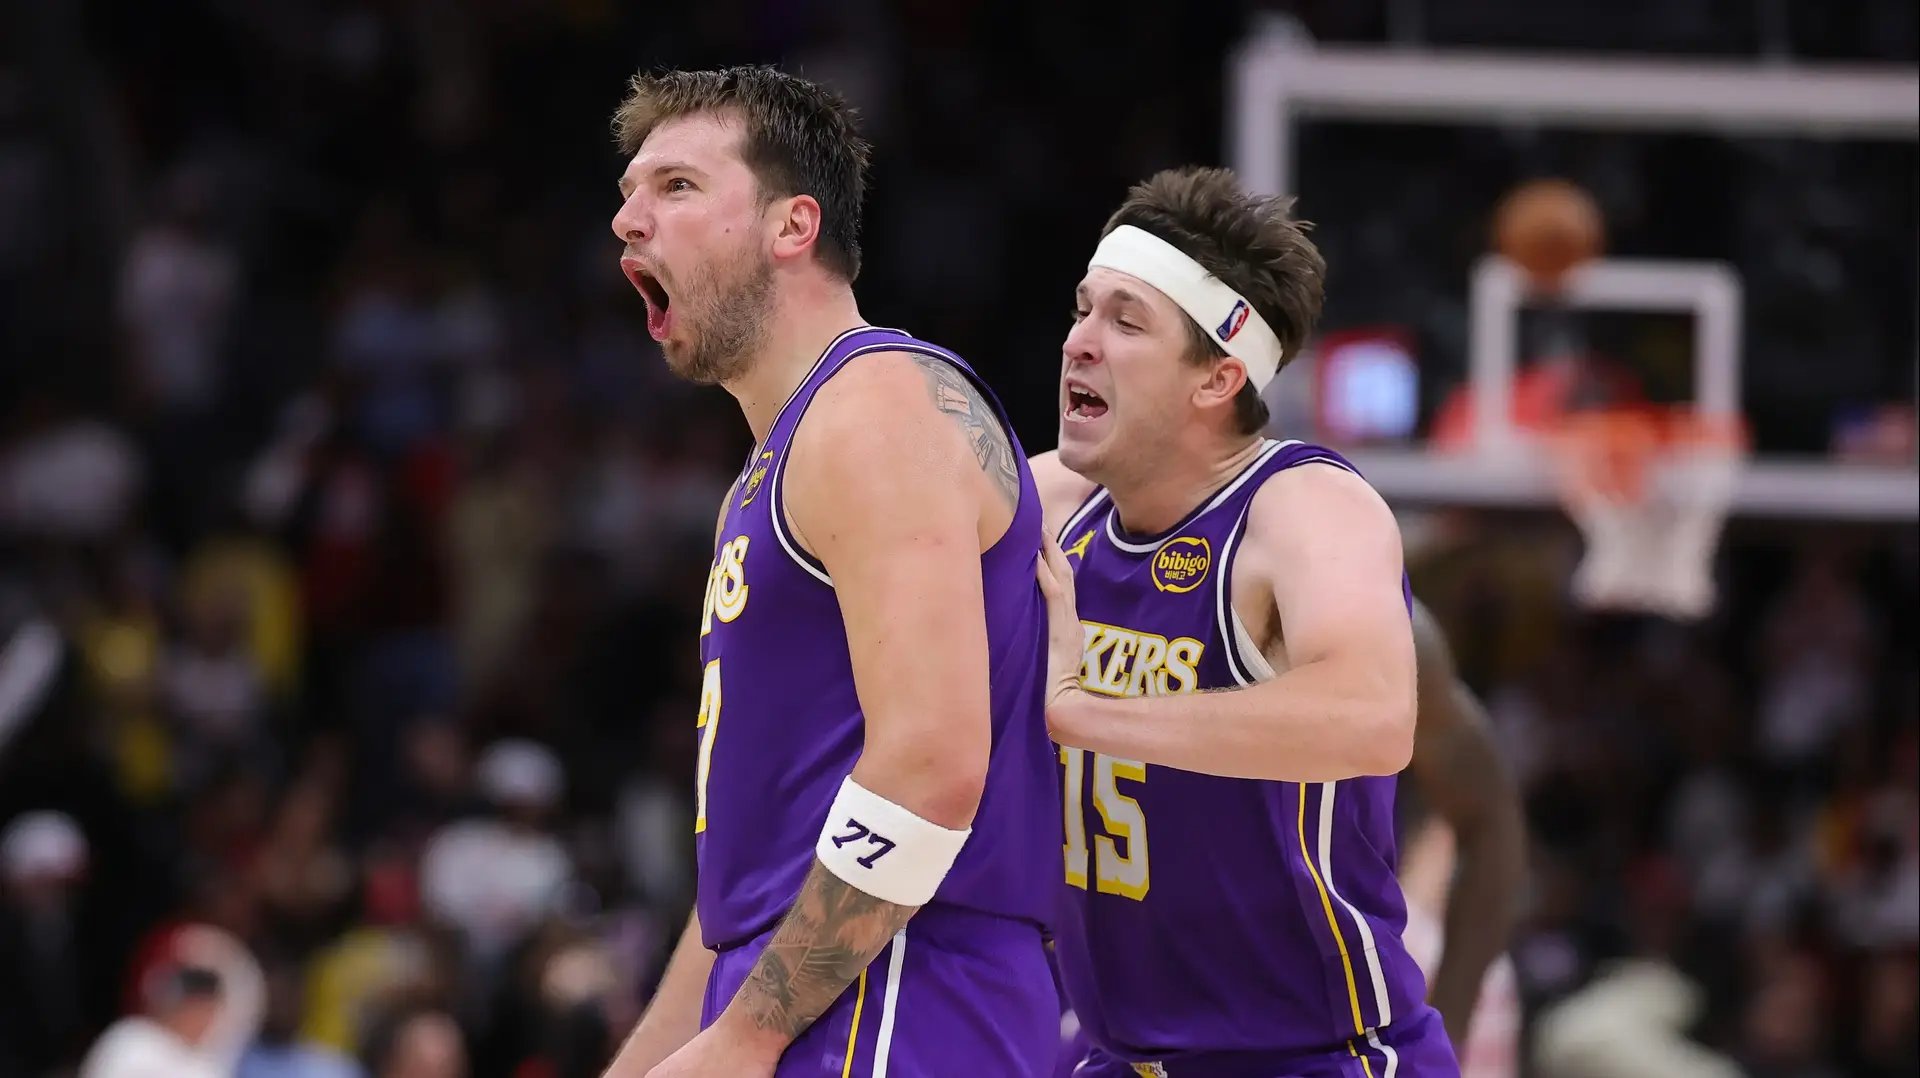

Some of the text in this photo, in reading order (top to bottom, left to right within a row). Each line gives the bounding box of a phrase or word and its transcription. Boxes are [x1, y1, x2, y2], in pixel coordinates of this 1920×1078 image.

[1158, 551, 1207, 577] bibigo
[1164, 570, 1186, 580] 비비고
[1060, 744, 1150, 901] 15
[831, 817, 897, 870] 77
